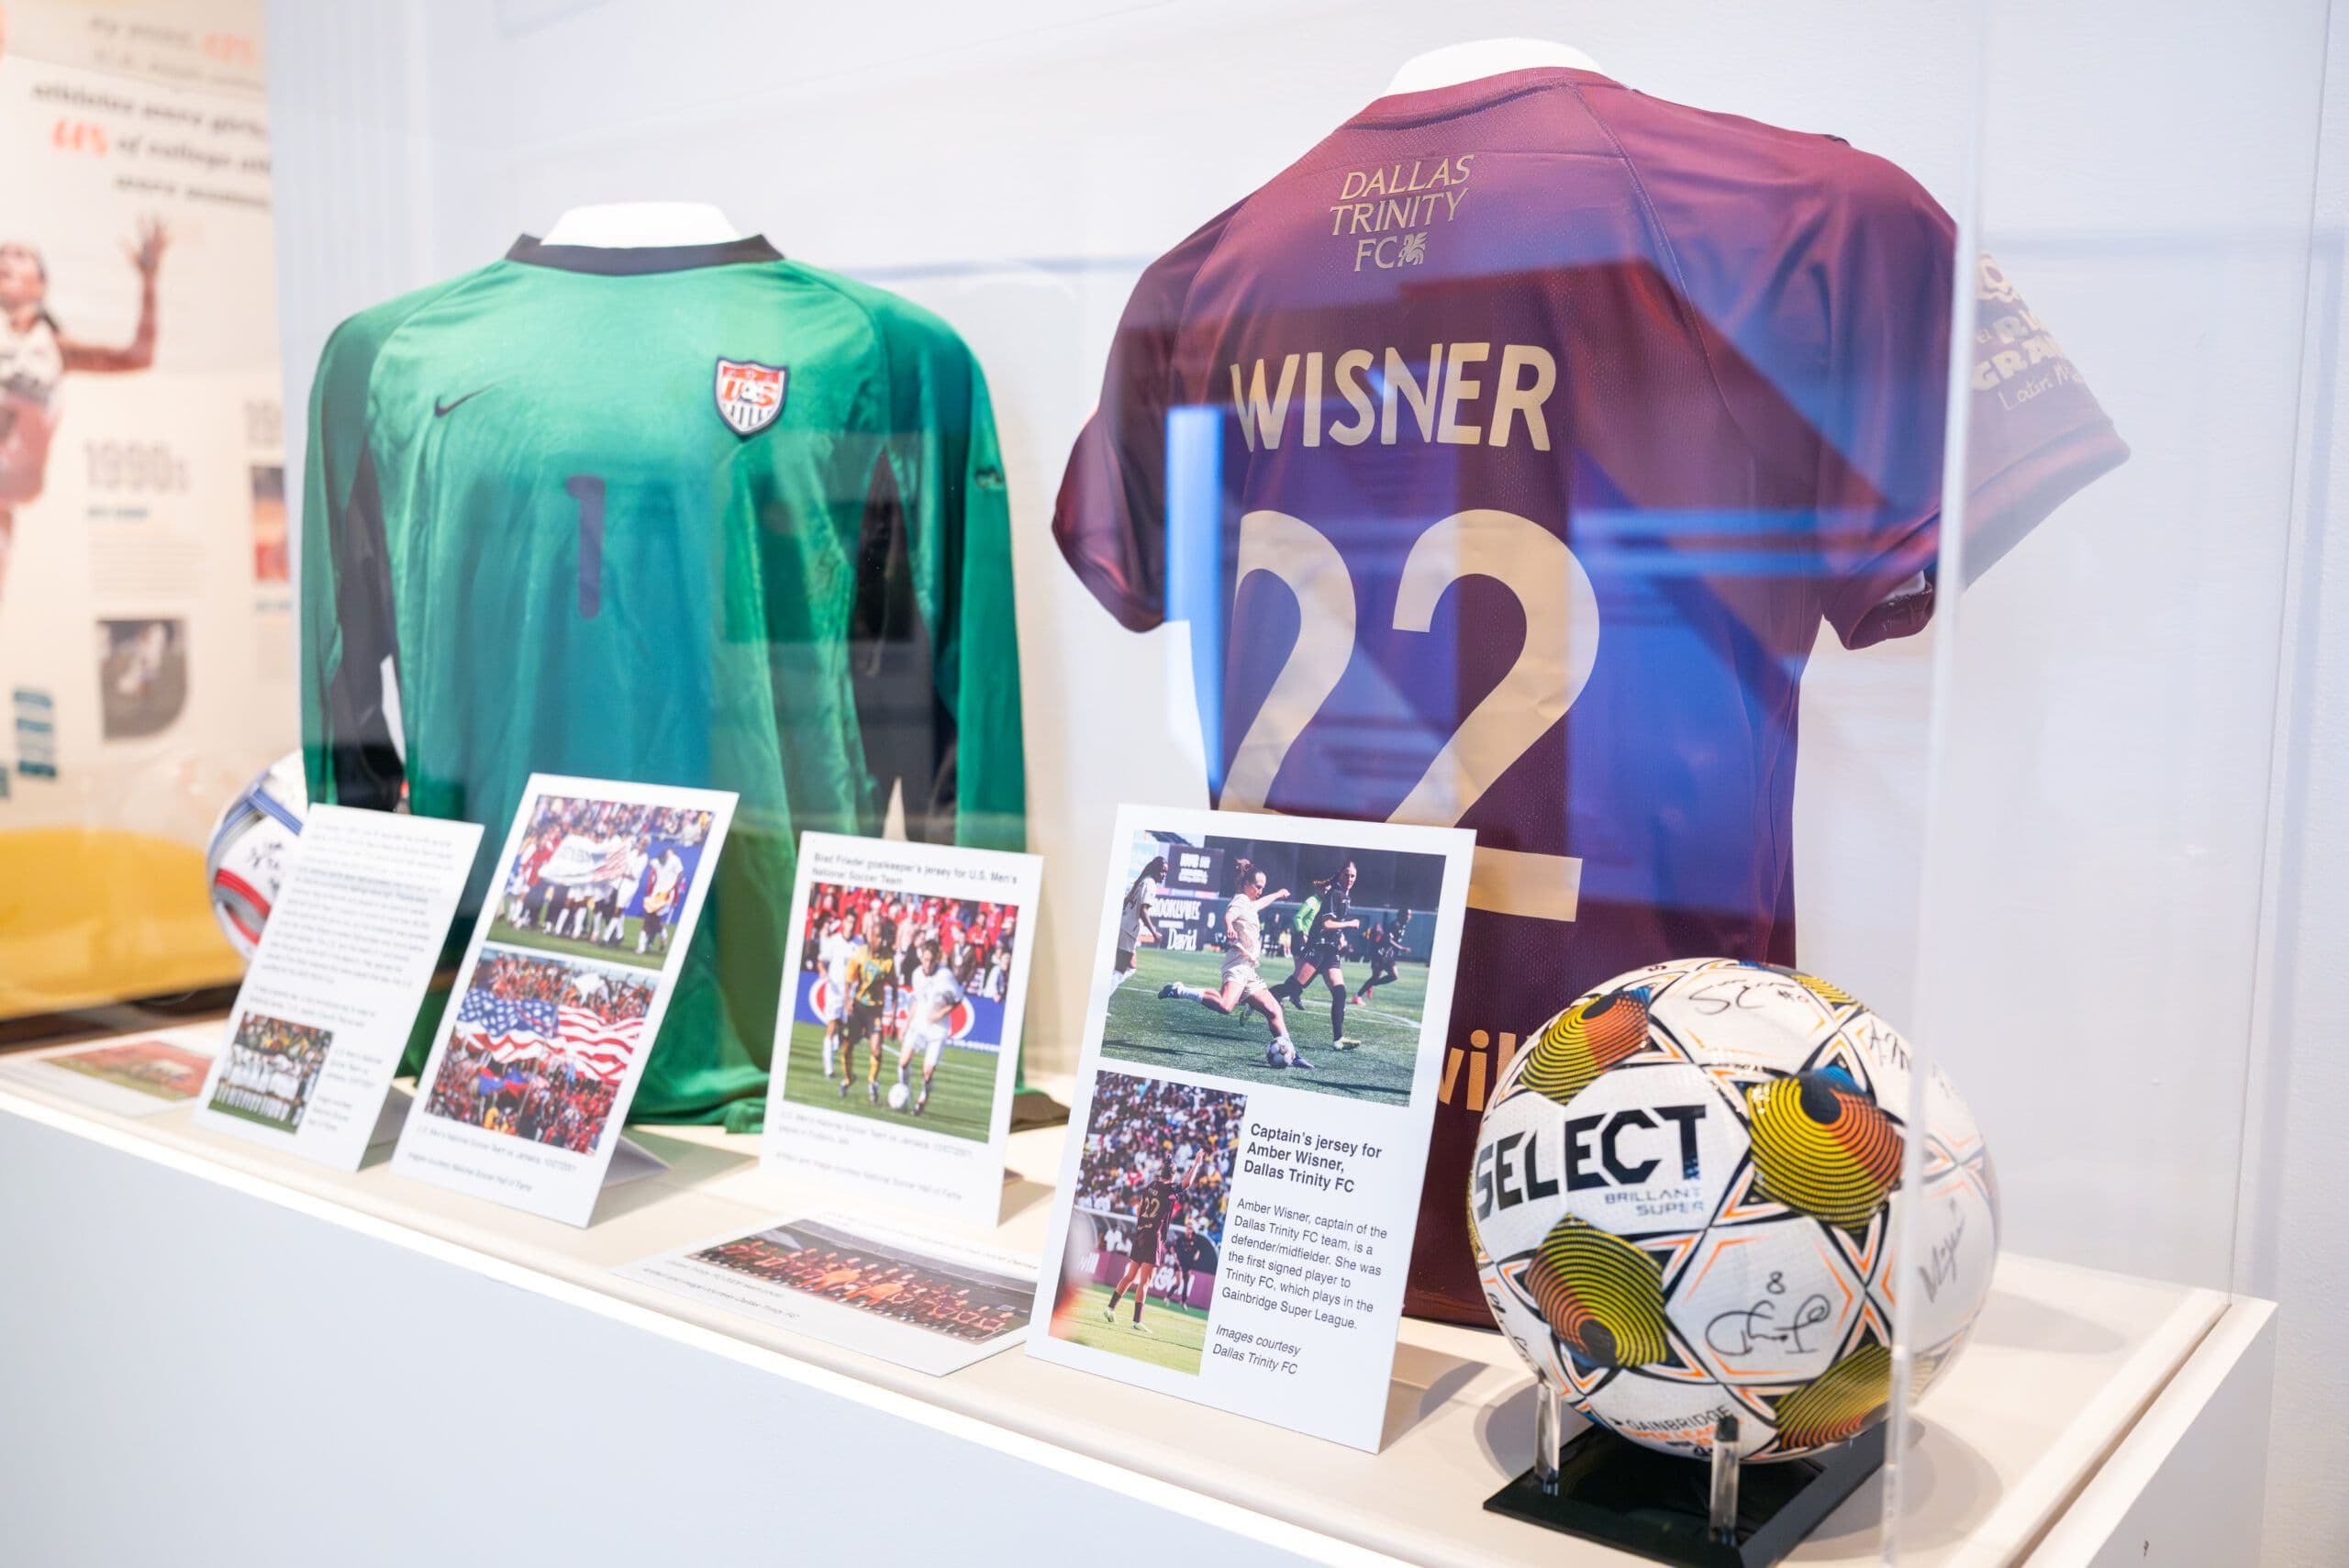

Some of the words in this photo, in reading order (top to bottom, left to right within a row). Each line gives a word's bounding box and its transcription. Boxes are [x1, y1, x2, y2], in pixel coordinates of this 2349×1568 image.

[1340, 153, 1475, 200] DALLAS
[1330, 186, 1469, 236] TRINITY
[1354, 236, 1397, 272] FC
[1230, 341, 1558, 453] WISNER
[564, 474, 607, 621] 1
[1217, 507, 1600, 923] 22
[924, 864, 951, 879] jersey
[953, 867, 967, 877] for
[969, 870, 986, 881] U.S.
[991, 873, 1019, 884] Men's
[1247, 1141, 1291, 1162] Amber
[1296, 1151, 1345, 1173] Wisner,
[1251, 1122, 1312, 1146] Captain's
[1315, 1135, 1358, 1157] jersey
[1362, 1142, 1382, 1159] for
[1244, 1160, 1285, 1180] Dallas
[1288, 1168, 1330, 1191] Trinity
[1335, 1177, 1354, 1193] FC
[1475, 1104, 1706, 1221] SELECT
[1141, 1197, 1160, 1218] 22
[1605, 1187, 1700, 1205] BRILLANT
[1636, 1201, 1704, 1217] SUPER
[1234, 1215, 1265, 1232] Dallas
[1269, 1223, 1299, 1241] Trinity
[1303, 1231, 1319, 1243] FC
[1321, 1234, 1351, 1252] team,
[1354, 1241, 1364, 1253] is
[1365, 1245, 1374, 1255] a
[1237, 1198, 1271, 1216] Amber
[1274, 1206, 1312, 1225] Wisner,
[1315, 1216, 1353, 1234] captain
[1356, 1224, 1368, 1235] of
[1370, 1227, 1387, 1240] the
[1228, 1251, 1244, 1263] the
[1246, 1253, 1265, 1268] first
[1268, 1261, 1302, 1278] signed
[1305, 1268, 1338, 1287] player
[1341, 1276, 1351, 1288] to
[1230, 1233, 1332, 1265] defender/midfielder.
[1335, 1256, 1356, 1271] She
[1360, 1263, 1382, 1276] was
[1222, 1286, 1278, 1311] Gainbridge
[1280, 1301, 1312, 1318] Super
[1315, 1307, 1357, 1329] League.
[1225, 1268, 1256, 1287] Trinity
[1259, 1275, 1276, 1291] FC,
[1280, 1283, 1310, 1298] which
[1312, 1290, 1341, 1307] plays
[1343, 1296, 1353, 1308] in
[1356, 1299, 1374, 1313] the
[1212, 1343, 1245, 1362] Dallas
[1248, 1352, 1279, 1372] Trinity
[1281, 1362, 1298, 1374] FC
[1216, 1324, 1253, 1343] Images
[1255, 1334, 1301, 1357] courtesy
